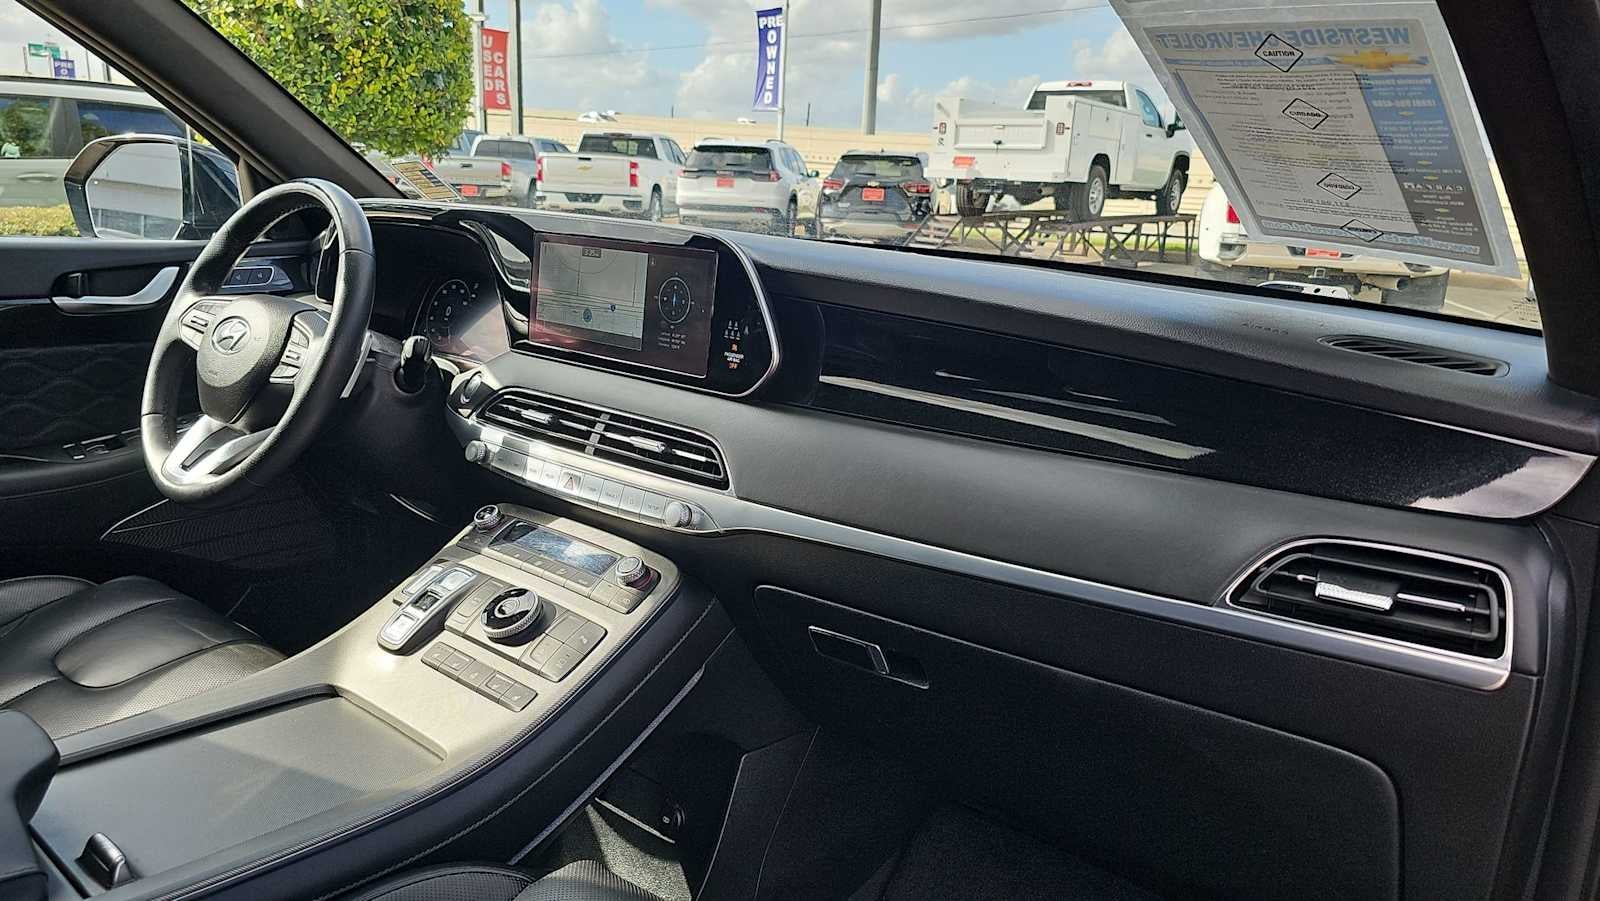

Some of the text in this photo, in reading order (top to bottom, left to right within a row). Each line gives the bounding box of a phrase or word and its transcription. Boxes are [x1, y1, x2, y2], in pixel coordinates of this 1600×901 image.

[759, 15, 784, 29] PRE
[482, 35, 494, 91] USED
[493, 51, 506, 105] CARS
[763, 30, 778, 105] OWNED
